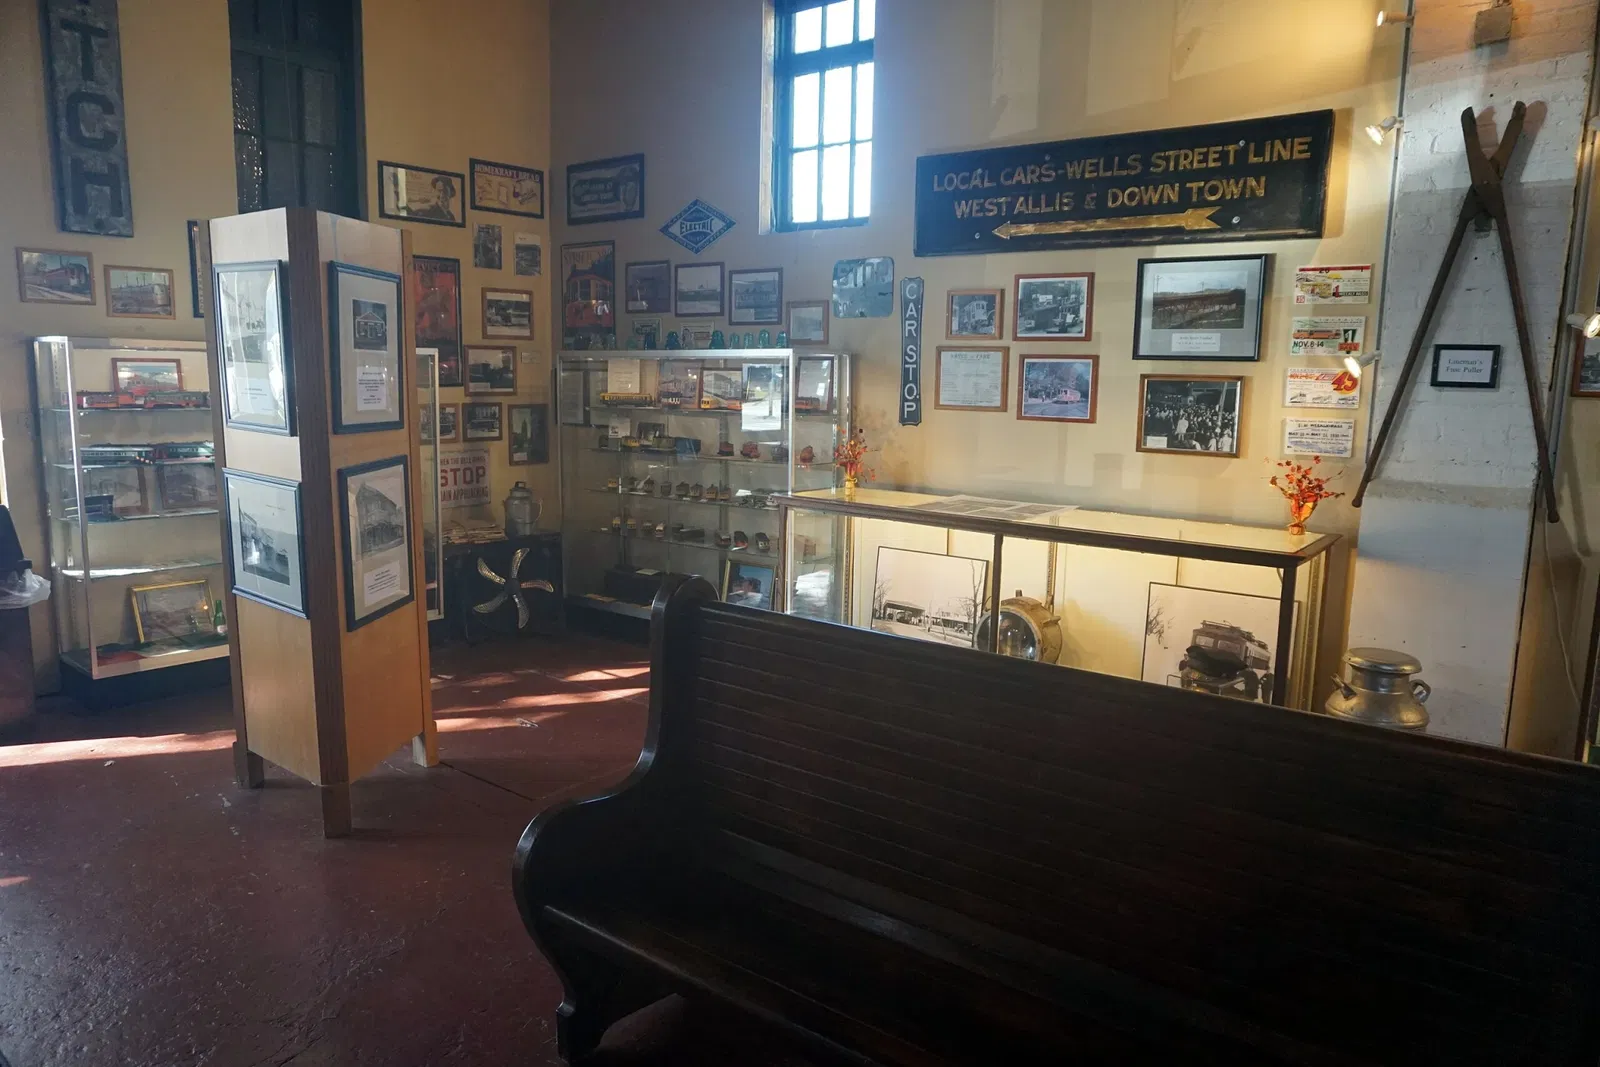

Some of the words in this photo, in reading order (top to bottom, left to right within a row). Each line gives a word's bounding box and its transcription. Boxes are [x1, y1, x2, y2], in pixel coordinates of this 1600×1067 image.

[933, 168, 997, 192] LOCAL
[1150, 143, 1241, 173] STREET
[1248, 136, 1312, 164] LINE
[953, 197, 1011, 219] WEST
[1013, 190, 1075, 216] ALLIS
[1107, 183, 1179, 208] DOWN
[1186, 175, 1266, 201] TOWN
[680, 218, 714, 235] ELECTRIC
[905, 283, 918, 337] CAR
[904, 345, 918, 419] STOP
[1331, 371, 1358, 391] 45
[1463, 366, 1483, 374] Puller
[441, 466, 486, 487] STOP
